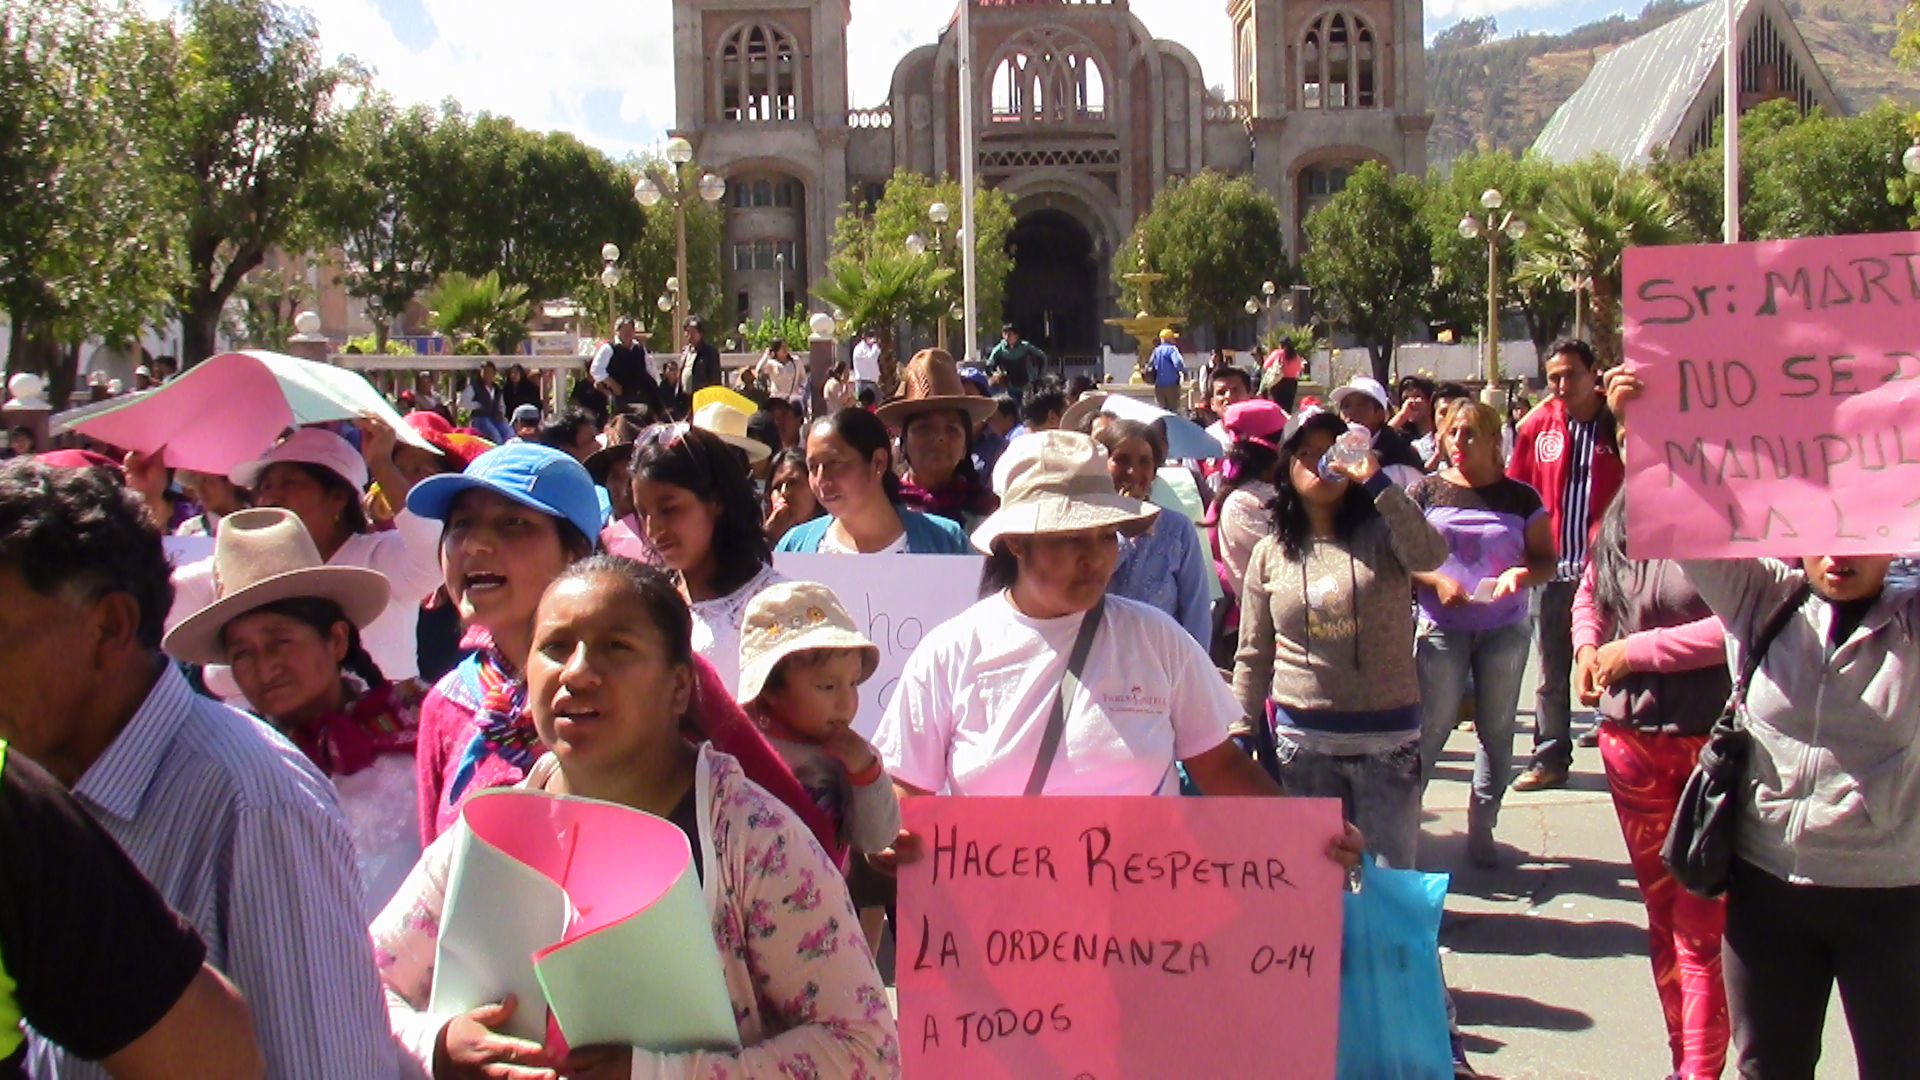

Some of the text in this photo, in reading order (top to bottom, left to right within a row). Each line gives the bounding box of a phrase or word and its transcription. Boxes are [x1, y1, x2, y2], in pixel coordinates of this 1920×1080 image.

[1637, 278, 1737, 326] Sr:
[1678, 359, 1757, 412] NO
[1780, 353, 1862, 397] SE
[1665, 425, 1920, 488] MANIPUL
[1729, 503, 1799, 542] LA
[932, 822, 1297, 891] HACER RESPETAR
[913, 914, 960, 971] LA
[986, 928, 1210, 975] ORDENANZA
[922, 1002, 1072, 1054] A TODOS
